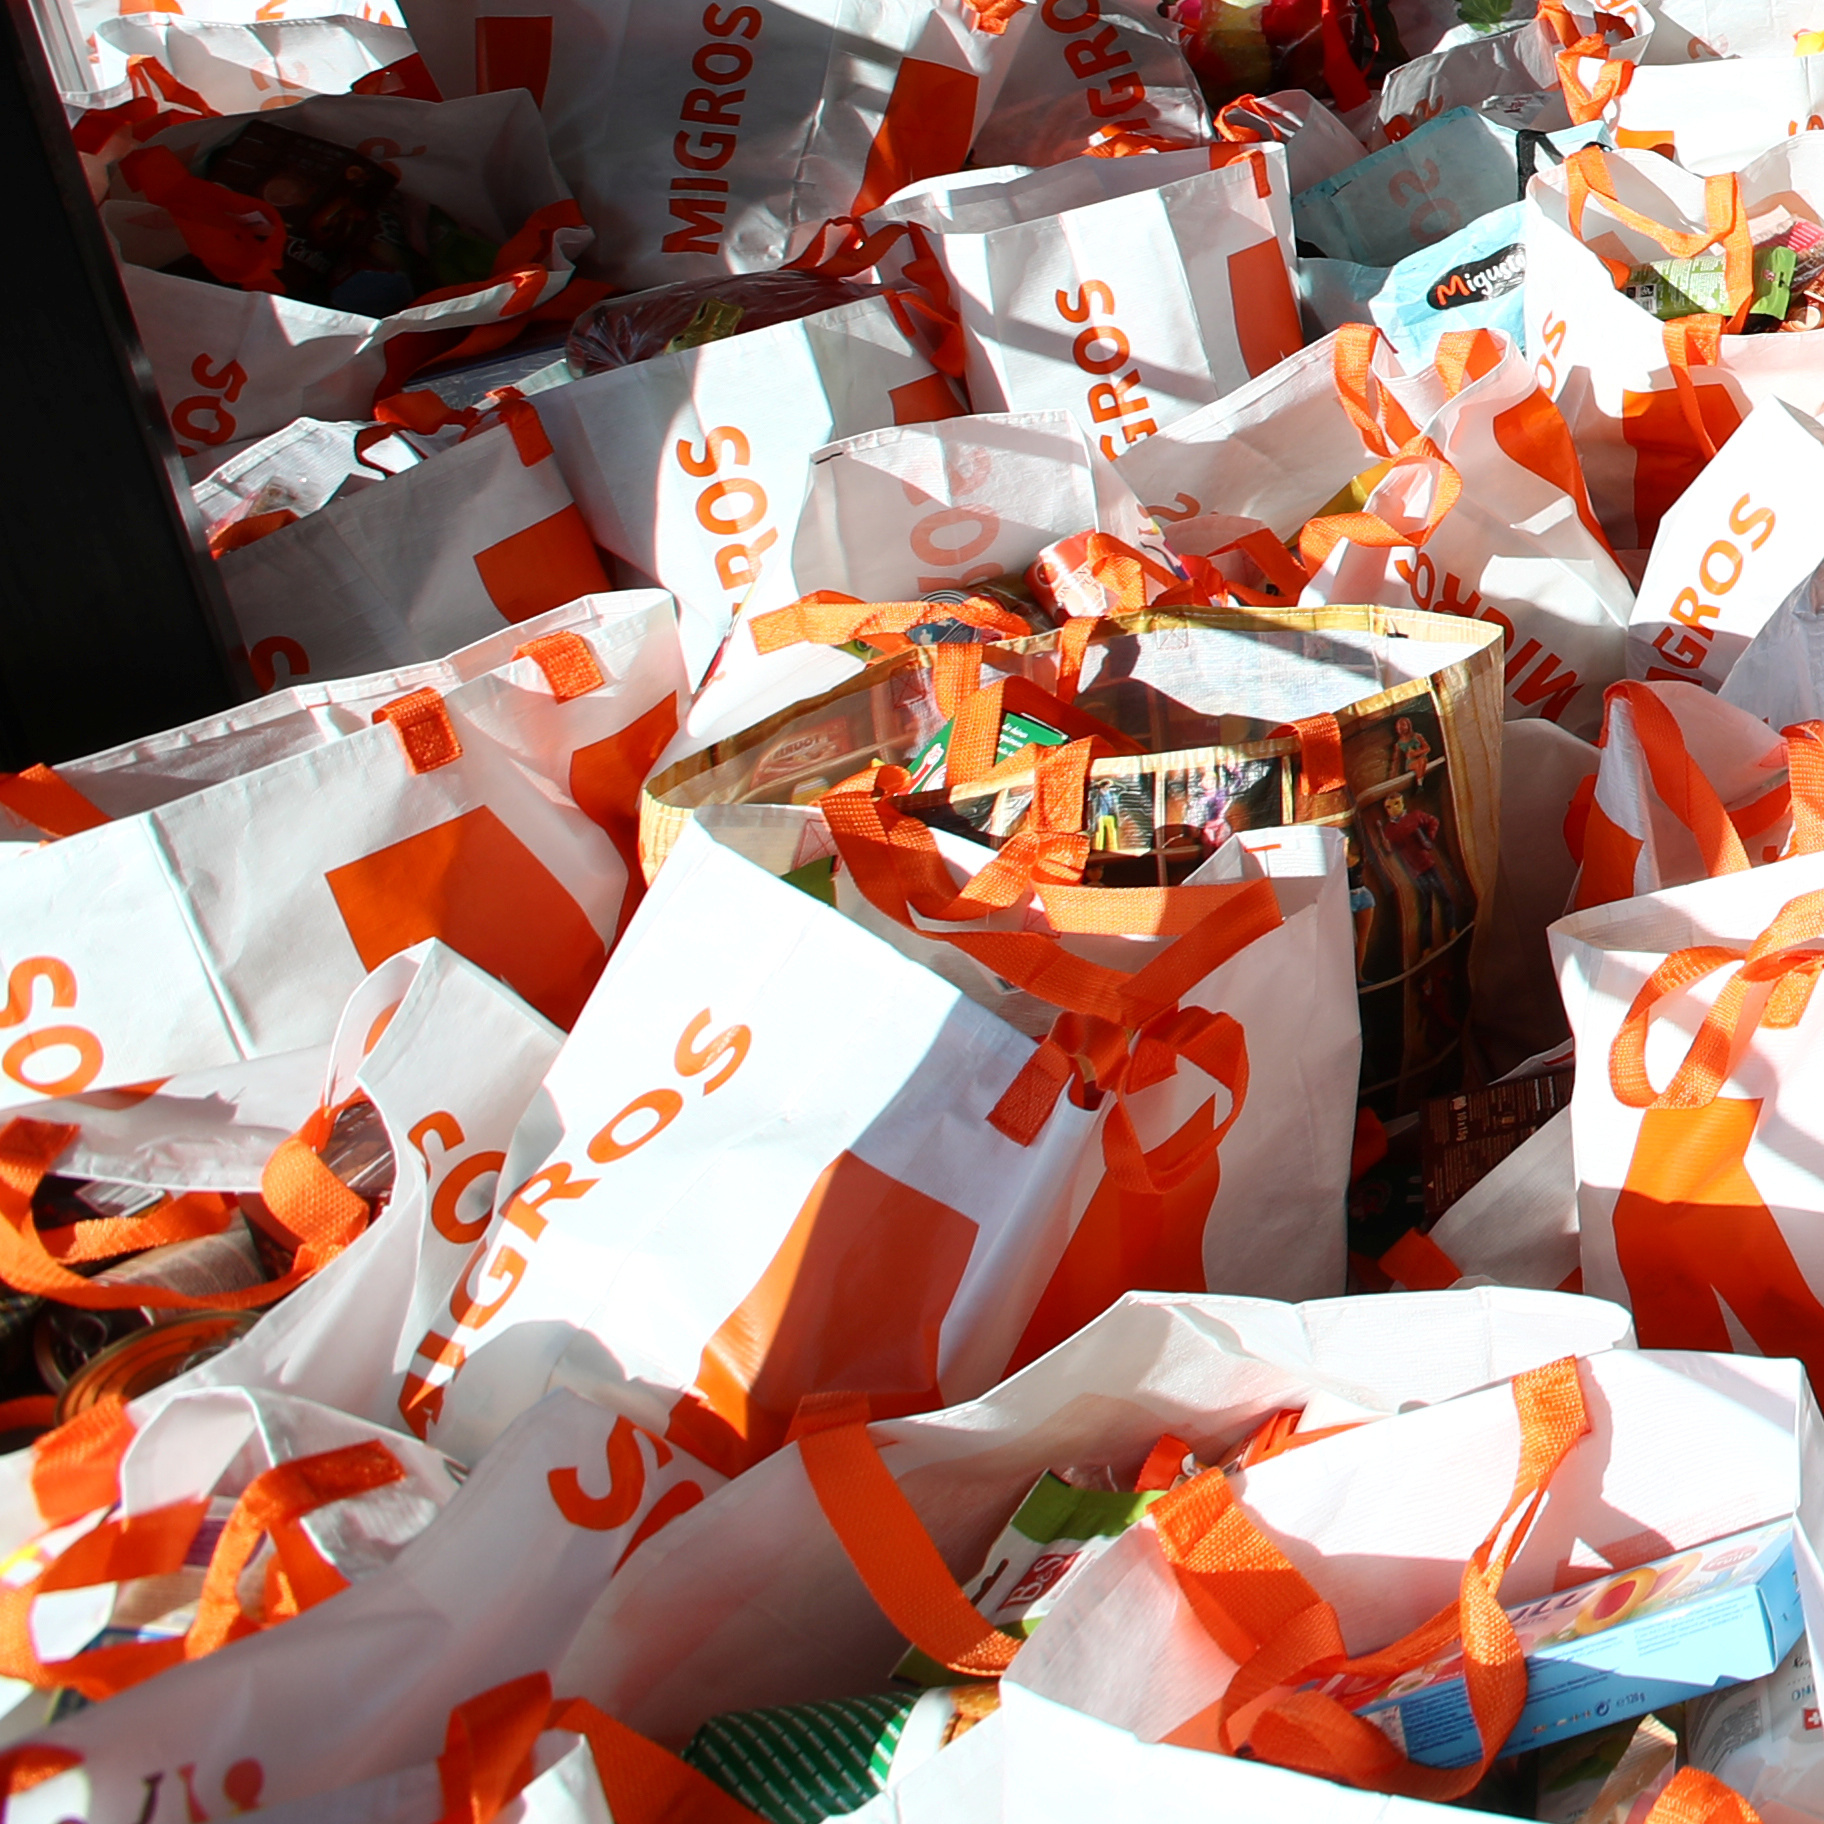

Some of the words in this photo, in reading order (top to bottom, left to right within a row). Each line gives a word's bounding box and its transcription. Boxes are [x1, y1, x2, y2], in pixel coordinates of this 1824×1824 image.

[662, 2, 763, 256] MIGROS
[1055, 278, 1158, 461] GROS
[678, 424, 778, 598] ROS
[1646, 491, 1778, 682] IGROS
